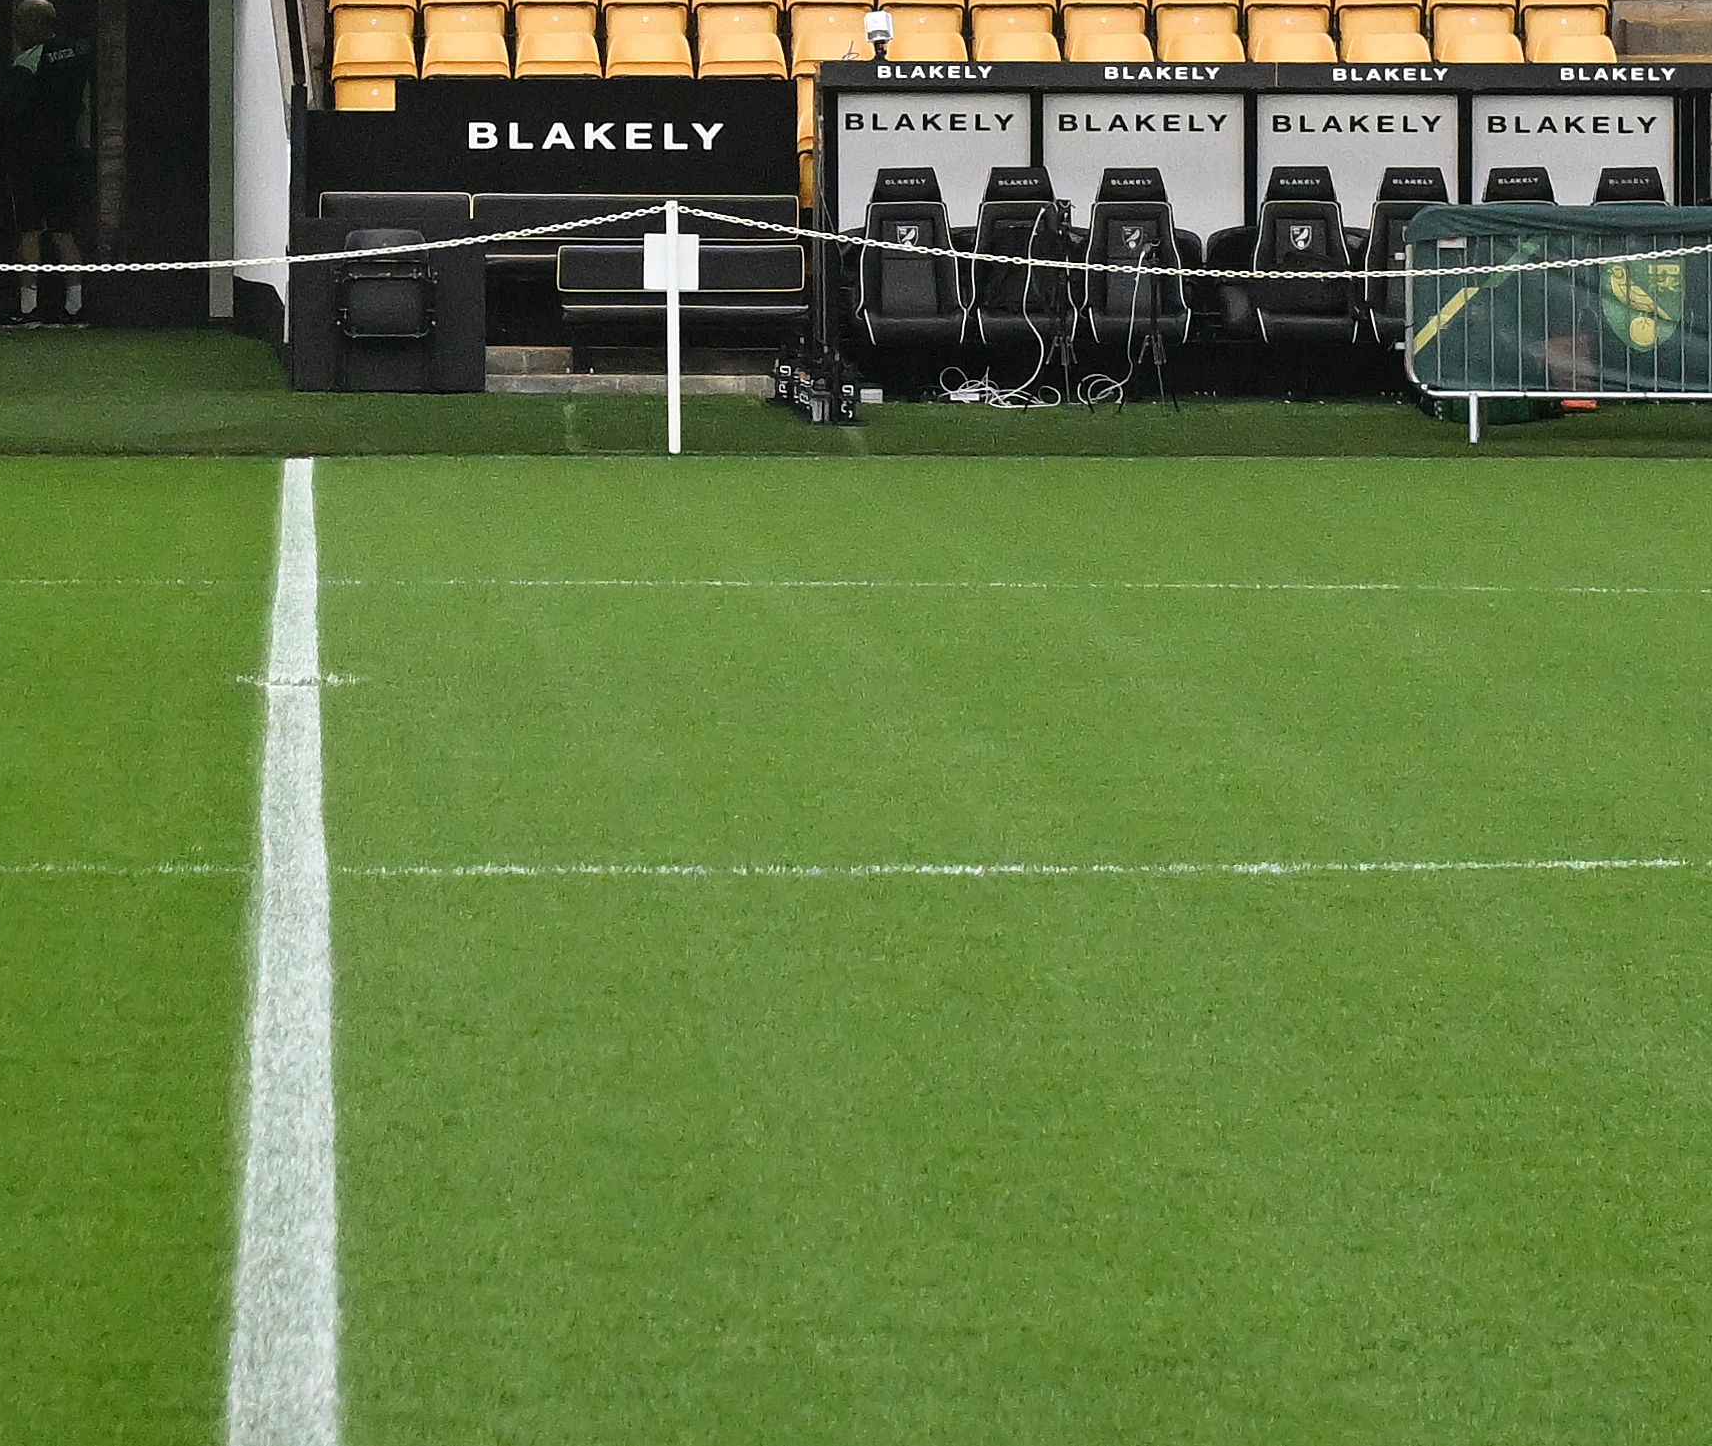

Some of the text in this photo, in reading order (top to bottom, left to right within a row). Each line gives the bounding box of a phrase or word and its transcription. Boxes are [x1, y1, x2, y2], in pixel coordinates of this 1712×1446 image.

[877, 65, 993, 79] BLAKELY
[1104, 66, 1220, 80] BLAKELY
[1332, 67, 1449, 82] BLAKELY
[1560, 67, 1676, 81] BLAKELY
[845, 113, 1014, 132] BLAKELY
[1058, 113, 1227, 132] BLAKELY
[1272, 114, 1441, 133] BLAKELY
[1487, 115, 1657, 134] BLAKELY
[468, 122, 724, 150] BLAKELY
[884, 178, 926, 186] BLAKELY
[1497, 177, 1539, 185] BLAKELY
